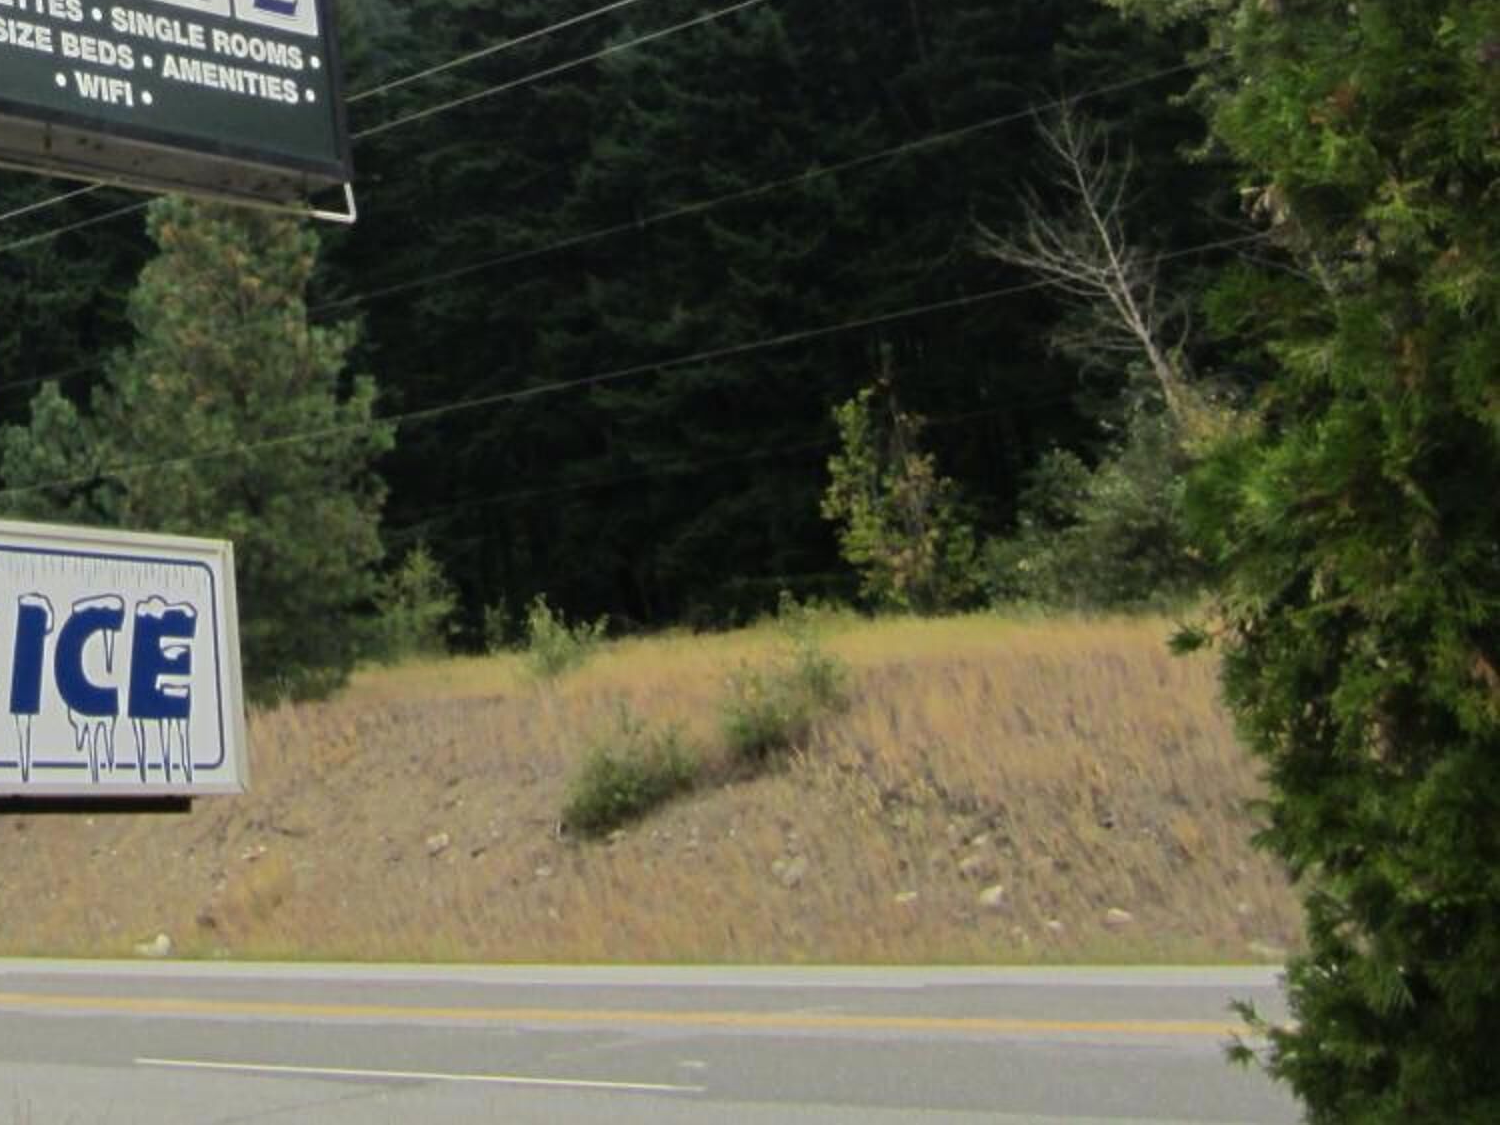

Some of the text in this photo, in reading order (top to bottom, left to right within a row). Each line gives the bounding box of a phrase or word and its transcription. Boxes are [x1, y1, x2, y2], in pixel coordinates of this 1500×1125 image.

[61, 32, 135, 71] BEDS
[162, 54, 300, 105] AMENITIES
[111, 6, 206, 49] SINGLE
[212, 30, 303, 70] ROOMS
[9, 592, 198, 721] ICE
